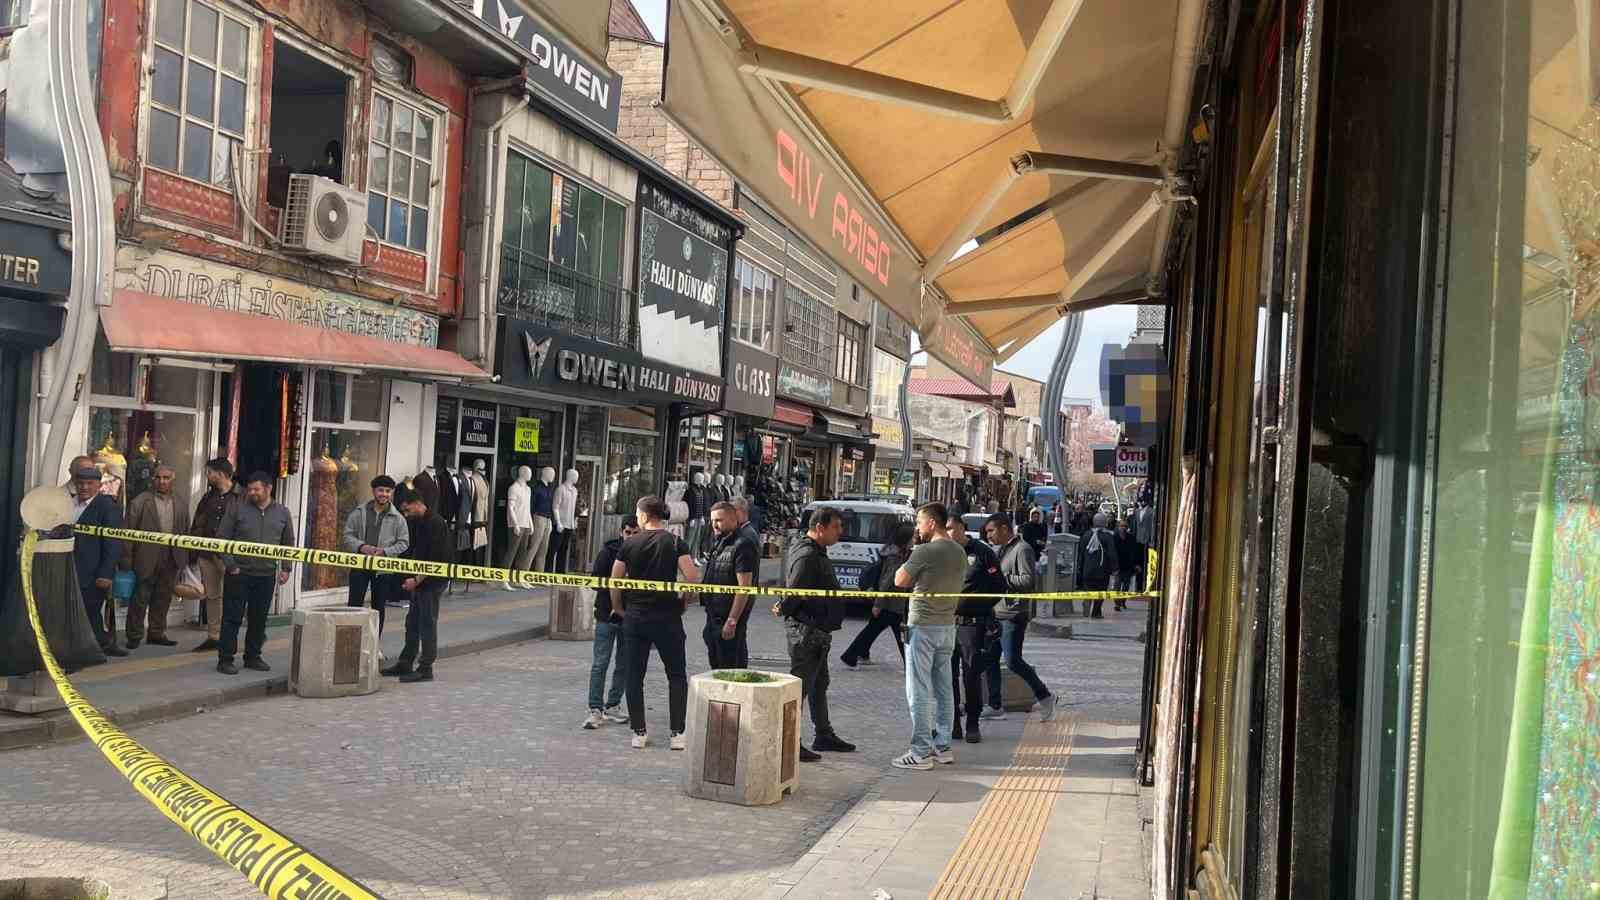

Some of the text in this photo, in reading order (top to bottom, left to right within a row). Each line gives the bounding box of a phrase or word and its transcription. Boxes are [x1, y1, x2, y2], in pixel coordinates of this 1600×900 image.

[531, 33, 609, 109] OWEN
[0, 254, 40, 284] TER
[651, 260, 717, 306] HALI DÜNYASI
[558, 350, 636, 392] OWEN
[640, 367, 721, 403] HALI DÜNYASI
[735, 362, 771, 397] CLASS
